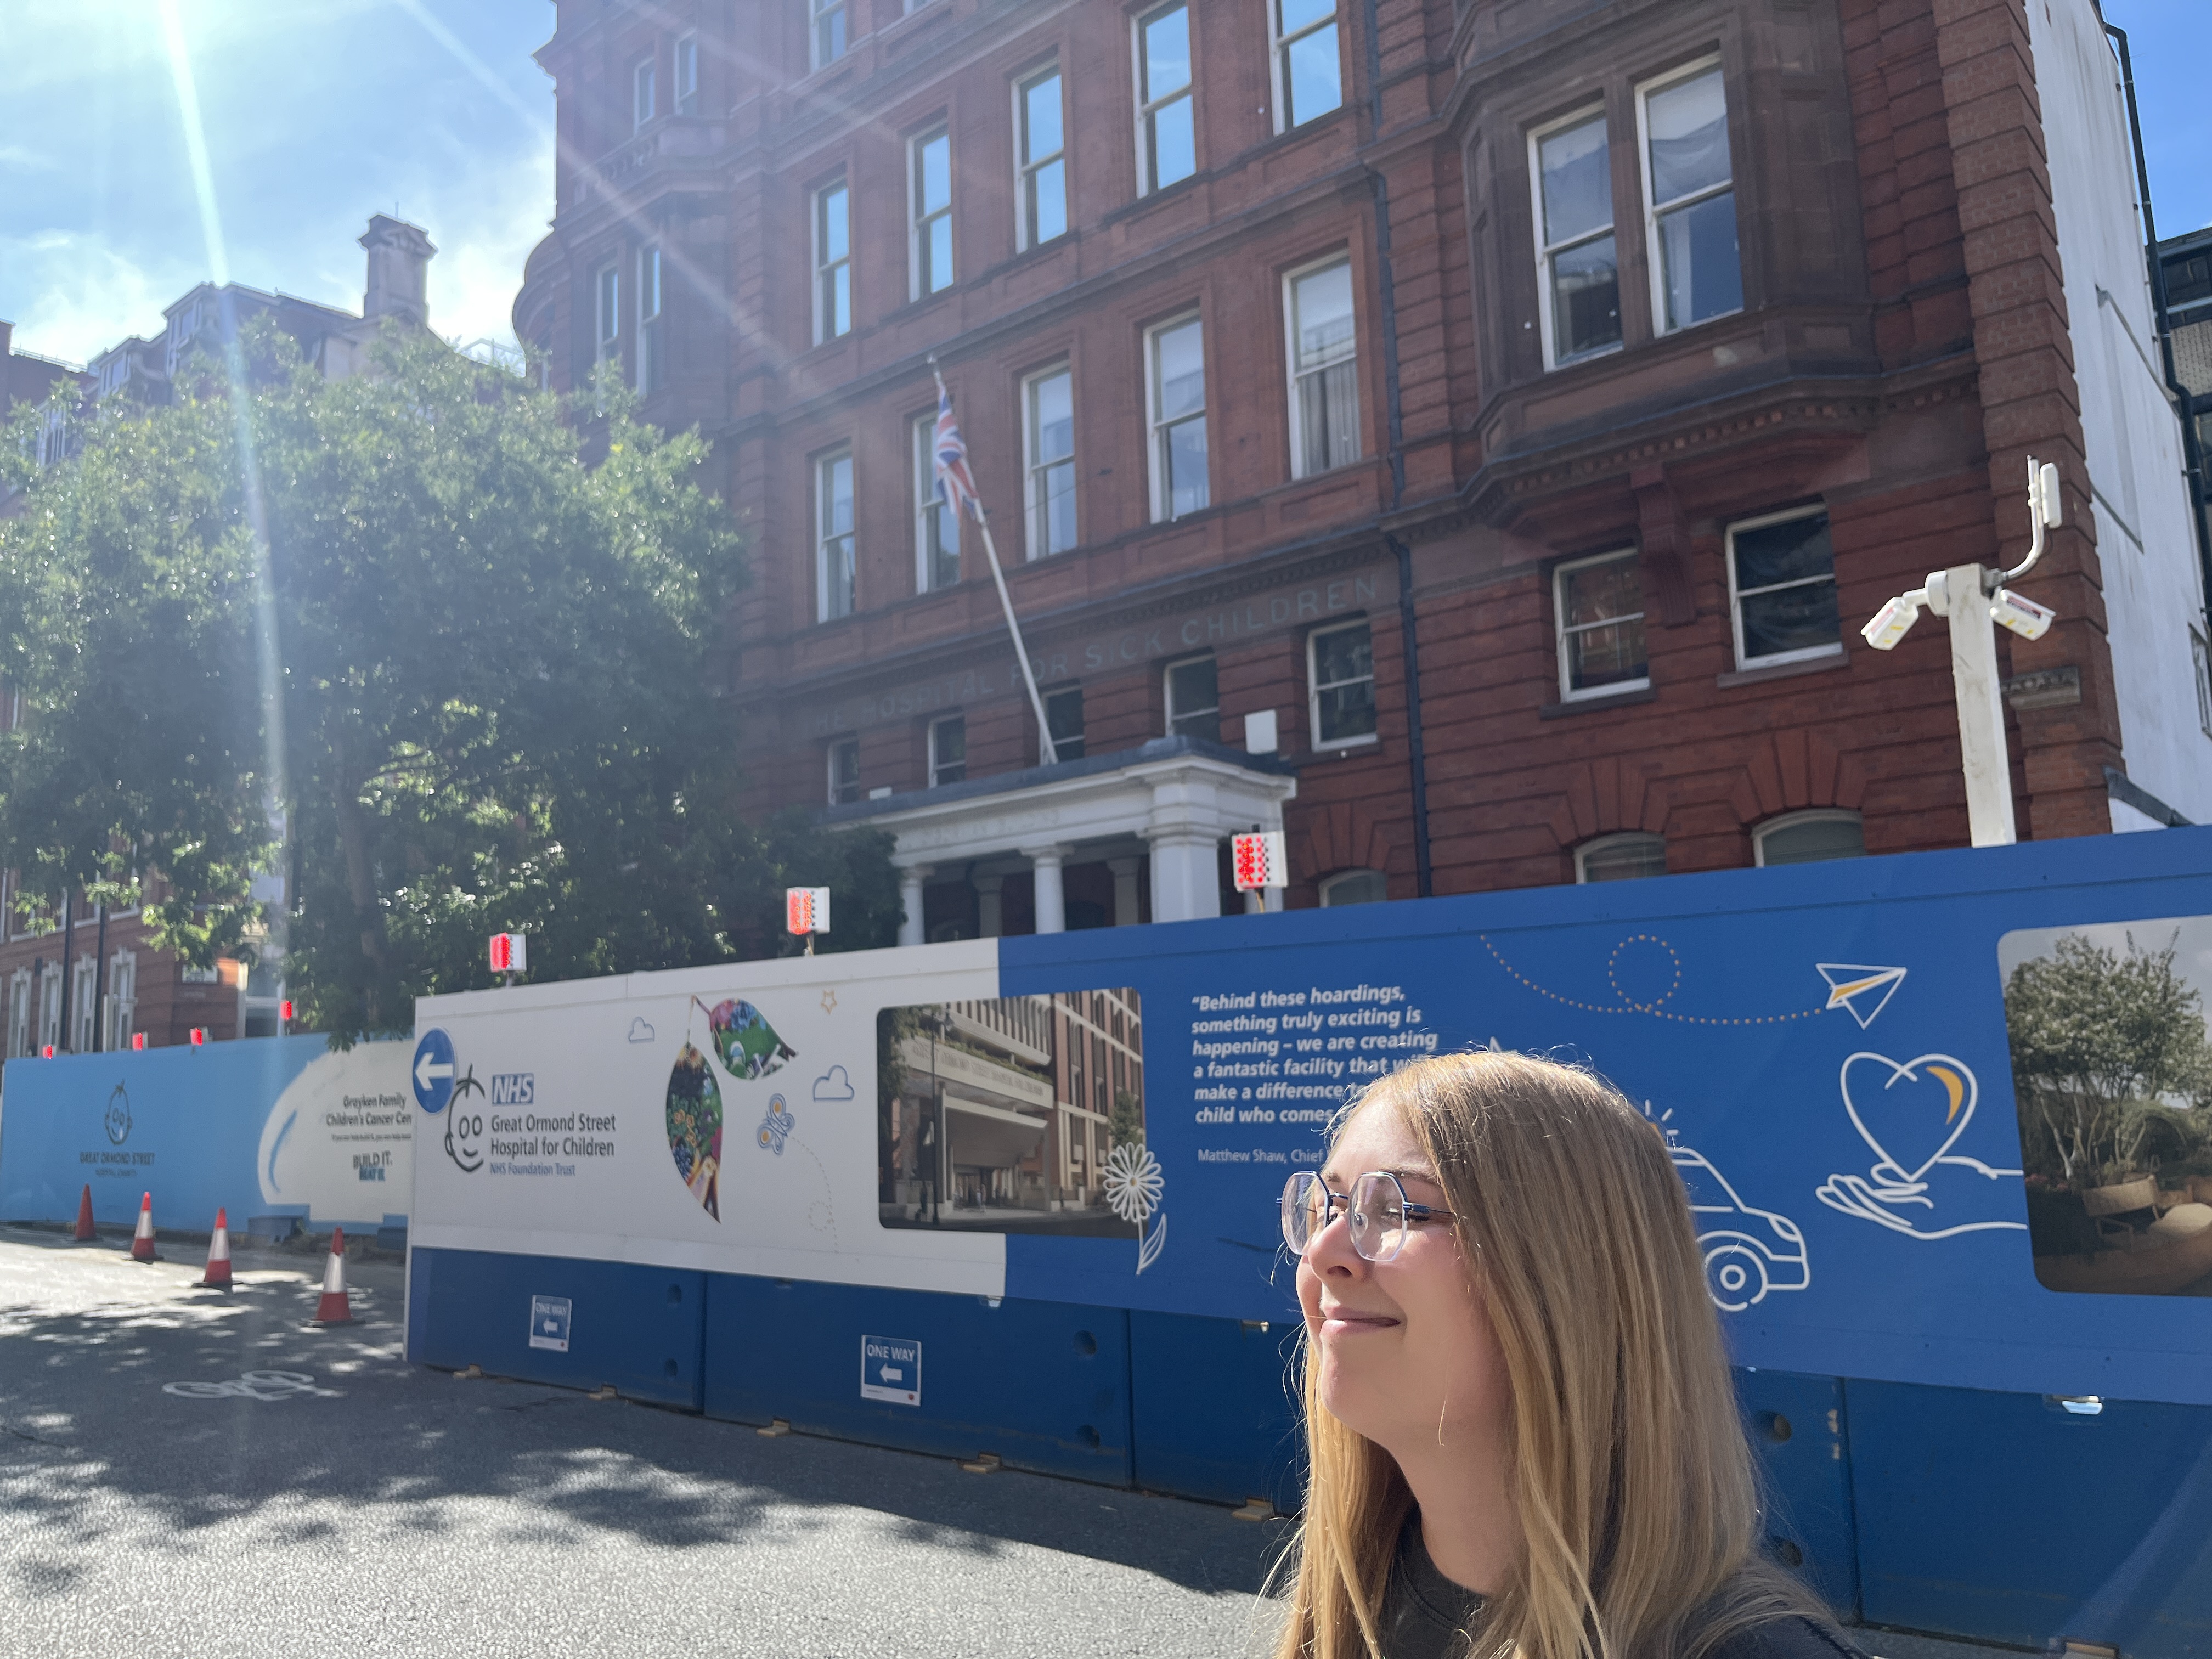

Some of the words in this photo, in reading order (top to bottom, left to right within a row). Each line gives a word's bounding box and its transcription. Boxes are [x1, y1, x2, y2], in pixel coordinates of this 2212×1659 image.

[861, 669, 994, 725] HOSPITAL
[1009, 653, 1068, 688] FOR
[1085, 628, 1164, 669] SICK
[1181, 575, 1377, 645] CHILDREN
[1260, 990, 1306, 1008] these
[1310, 984, 1406, 1005] hoardings,
[1192, 1014, 1277, 1035] something
[1282, 1011, 1323, 1032] truly
[1327, 1008, 1401, 1028] exciting
[1406, 1006, 1421, 1024] is
[1192, 1037, 1279, 1058] happening
[1296, 1037, 1323, 1052] we
[1327, 1036, 1355, 1051] are
[1359, 1030, 1438, 1051] creating
[1193, 1065, 1204, 1079] a
[1207, 1059, 1279, 1078] fantastic
[1283, 1058, 1345, 1079] facility
[1348, 1056, 1387, 1074] that
[494, 1076, 533, 1103] NHS
[1194, 1084, 1237, 1101] make
[1242, 1087, 1251, 1101] a
[1256, 1082, 1343, 1100] difference
[379, 1092, 407, 1111] Family
[365, 1112, 393, 1126] Cancer
[492, 1115, 522, 1132] Great
[526, 1112, 575, 1132] Ormond
[579, 1113, 616, 1132] Street
[1195, 1107, 1235, 1124] child
[1239, 1106, 1276, 1123] who
[1279, 1109, 1334, 1123] comes
[491, 1136, 538, 1160] Hospital
[542, 1135, 559, 1156] for
[563, 1136, 614, 1157] Children
[1198, 1149, 1250, 1163] Matthew
[1252, 1149, 1288, 1164] Shaw,
[1291, 1149, 1324, 1163] Chief
[100, 1152, 131, 1165] ORMOND
[132, 1152, 156, 1165] STREET
[353, 1153, 380, 1169] BUILD
[490, 1162, 506, 1176] NHS
[508, 1162, 554, 1176] Foundation
[555, 1163, 575, 1176] Trust
[867, 1344, 889, 1359] ONE
[890, 1347, 915, 1362] WAY
